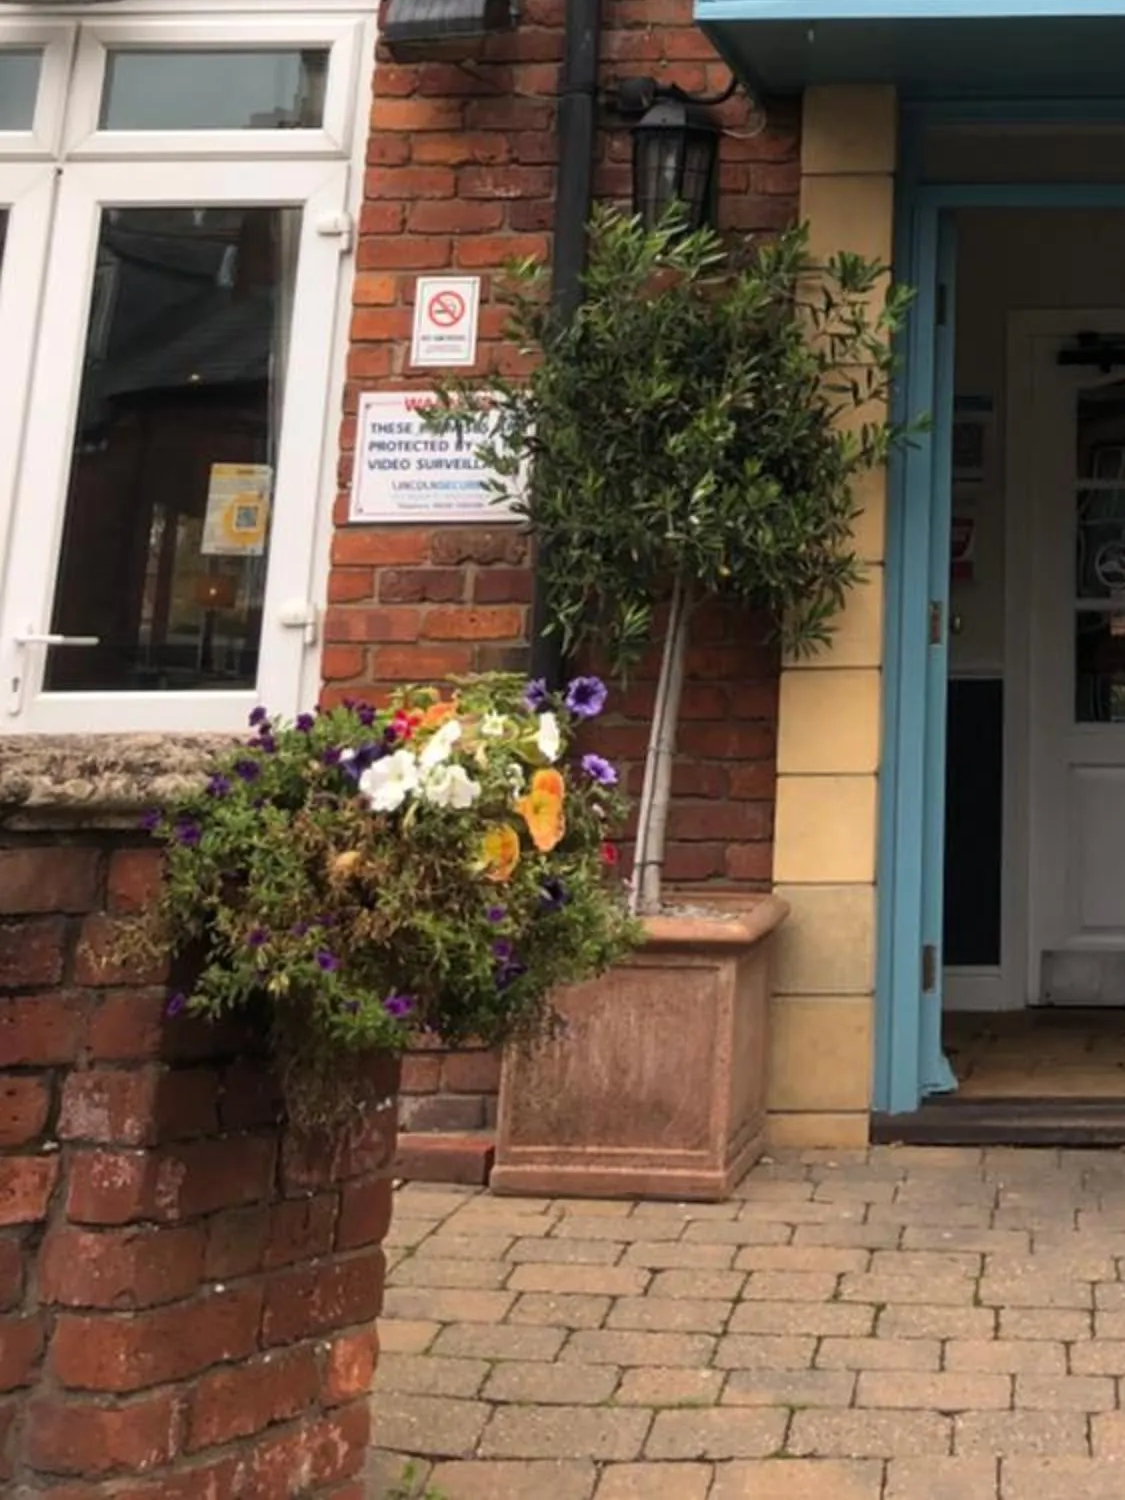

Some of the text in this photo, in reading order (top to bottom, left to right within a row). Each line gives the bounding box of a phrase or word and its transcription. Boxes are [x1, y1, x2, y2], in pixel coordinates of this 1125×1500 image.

[370, 421, 412, 435] THESE
[368, 439, 450, 453] PROTECTED
[367, 457, 411, 470] VIDEO
